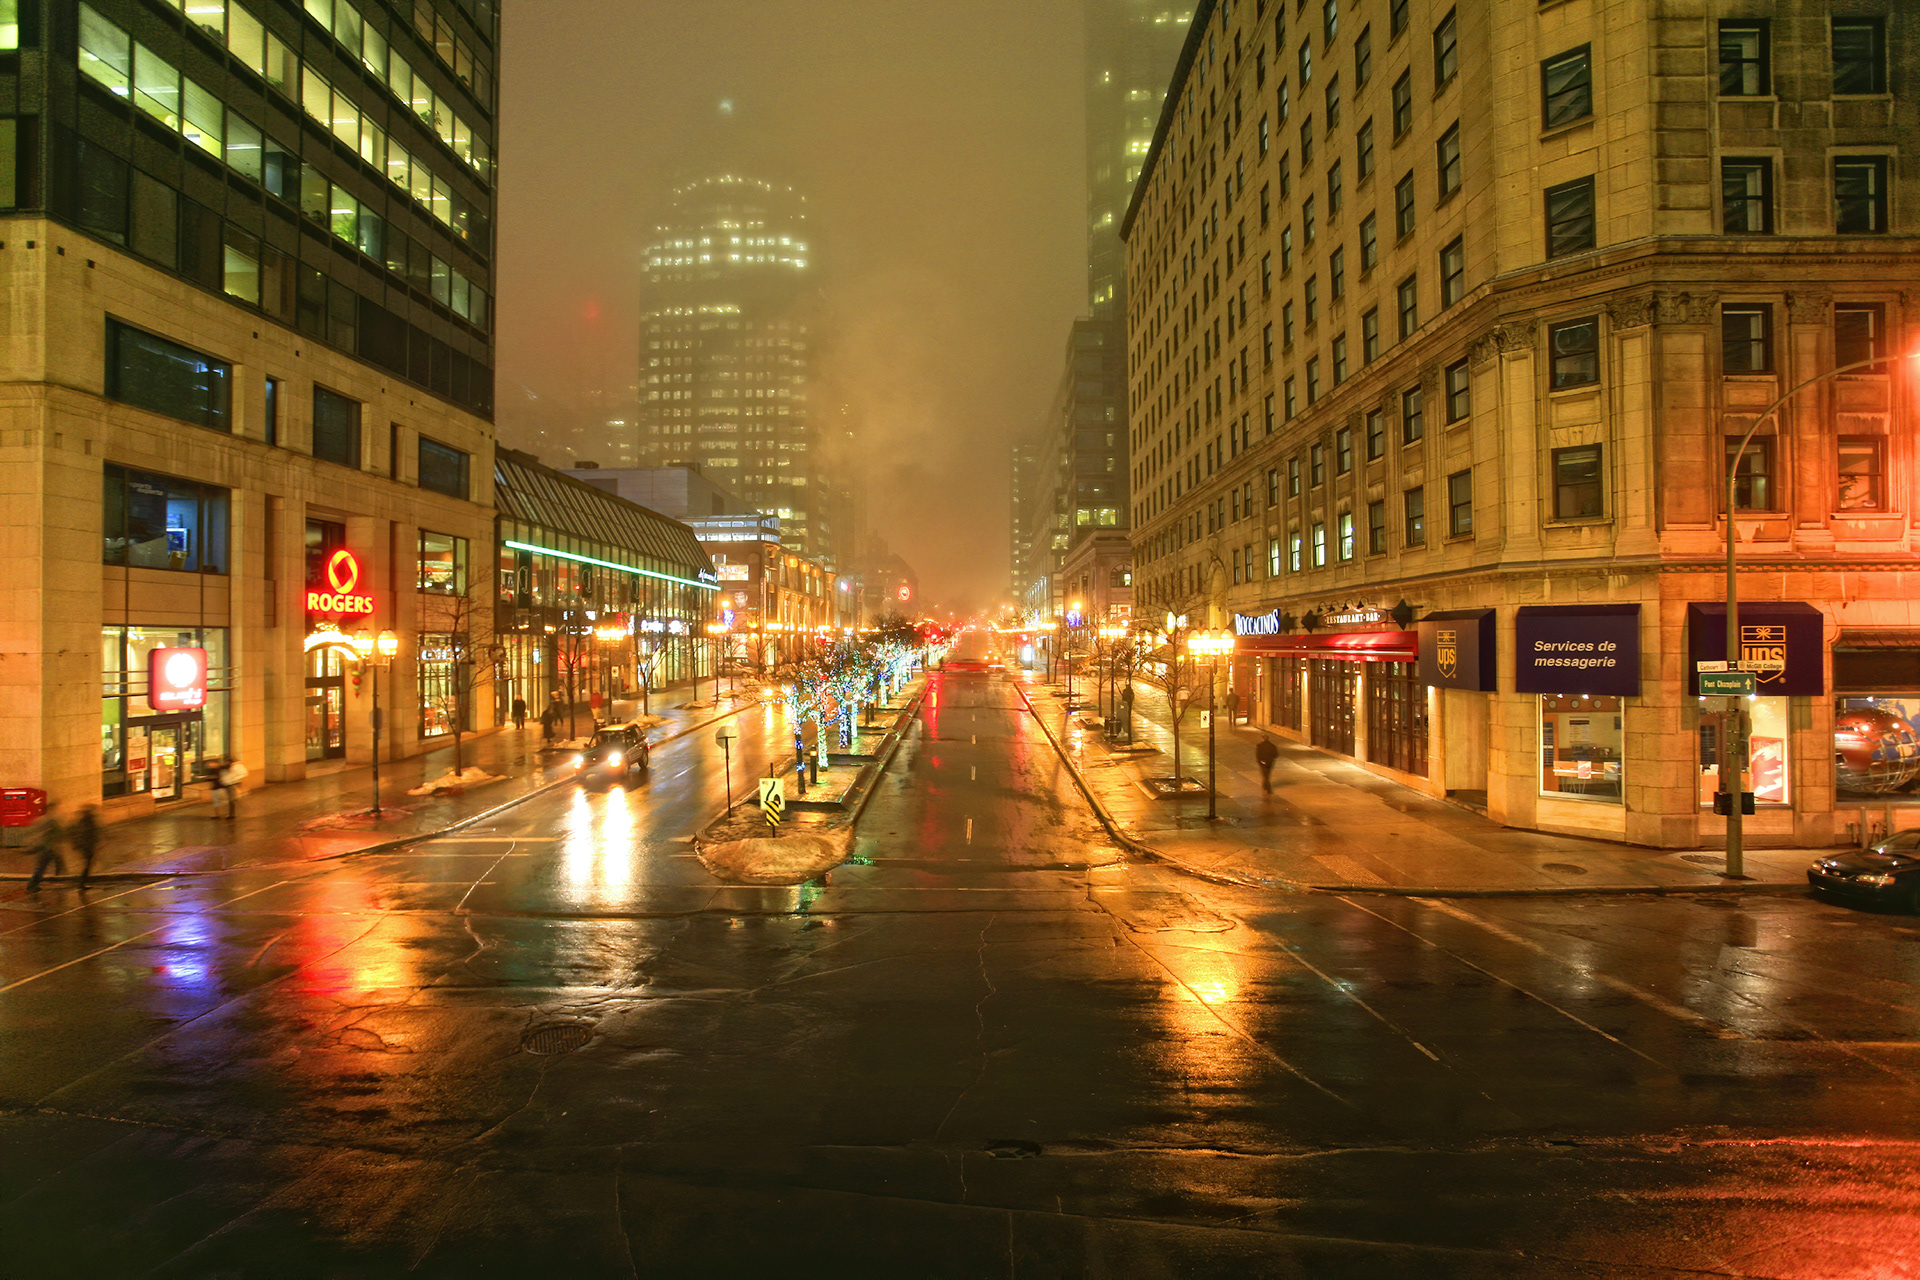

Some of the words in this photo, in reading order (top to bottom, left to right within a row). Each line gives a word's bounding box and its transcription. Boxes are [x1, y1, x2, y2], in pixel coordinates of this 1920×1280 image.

[308, 592, 373, 613] ROGERS
[1235, 608, 1280, 636] BOCCACINOS
[1534, 640, 1594, 652] Services
[1598, 640, 1617, 652] de
[1438, 648, 1455, 670] ups
[1534, 656, 1616, 670] messagerie
[1717, 680, 1741, 689] Champlain
